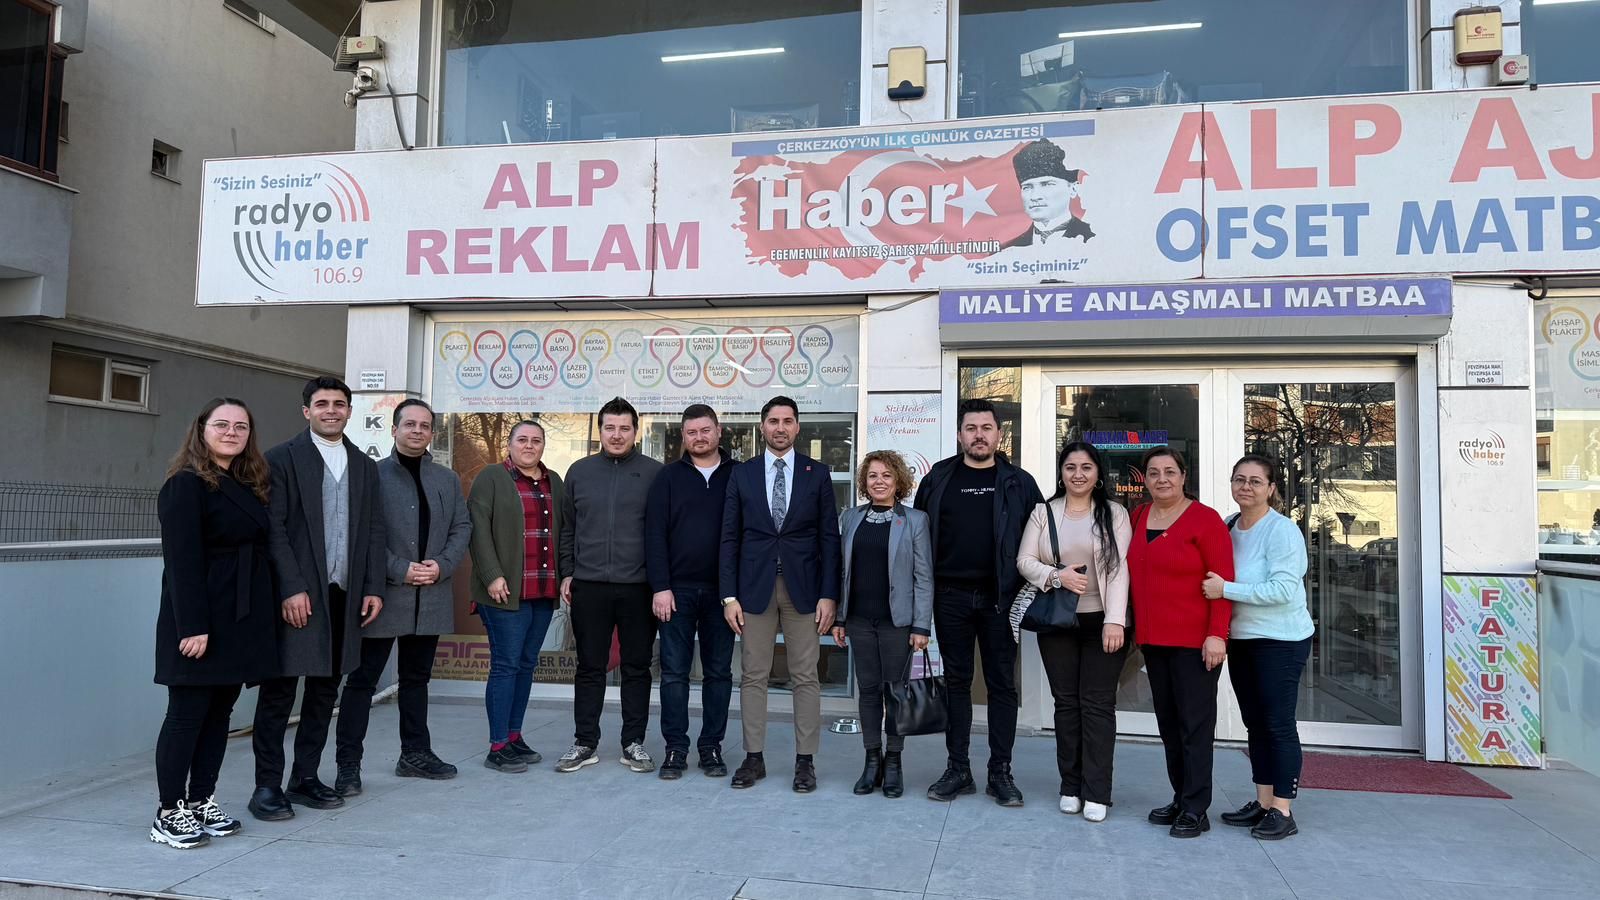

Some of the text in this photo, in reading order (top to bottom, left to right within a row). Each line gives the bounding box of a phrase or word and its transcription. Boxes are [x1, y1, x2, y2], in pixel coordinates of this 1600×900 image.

[884, 131, 907, 147] İLK
[909, 127, 969, 146] GÜNLÜK
[973, 122, 1045, 140] GAZETESİ
[1153, 104, 1402, 194] ALP
[483, 159, 620, 210] ALP
[234, 193, 332, 232] radyo
[756, 174, 957, 232] Haber
[1155, 195, 1600, 263] OFSET MATB
[274, 230, 369, 262] haber
[405, 221, 700, 276] REKLAM
[770, 244, 830, 261] EGEMENLİK
[832, 244, 880, 259] KAYITSIZ
[313, 266, 363, 285] 106.9
[958, 285, 1426, 316] MALİYE ANLAŞMALI MATBAA
[1549, 328, 1582, 336] PLAKET
[1551, 319, 1581, 328] AHŞAP
[566, 364, 587, 372] LAZER
[820, 364, 849, 374] GRAFİK
[1459, 438, 1493, 450] radyo
[1473, 449, 1505, 459] haber
[1116, 483, 1144, 492] haber
[434, 658, 489, 669] LP AJAN
[1479, 589, 1508, 749] FATURA
